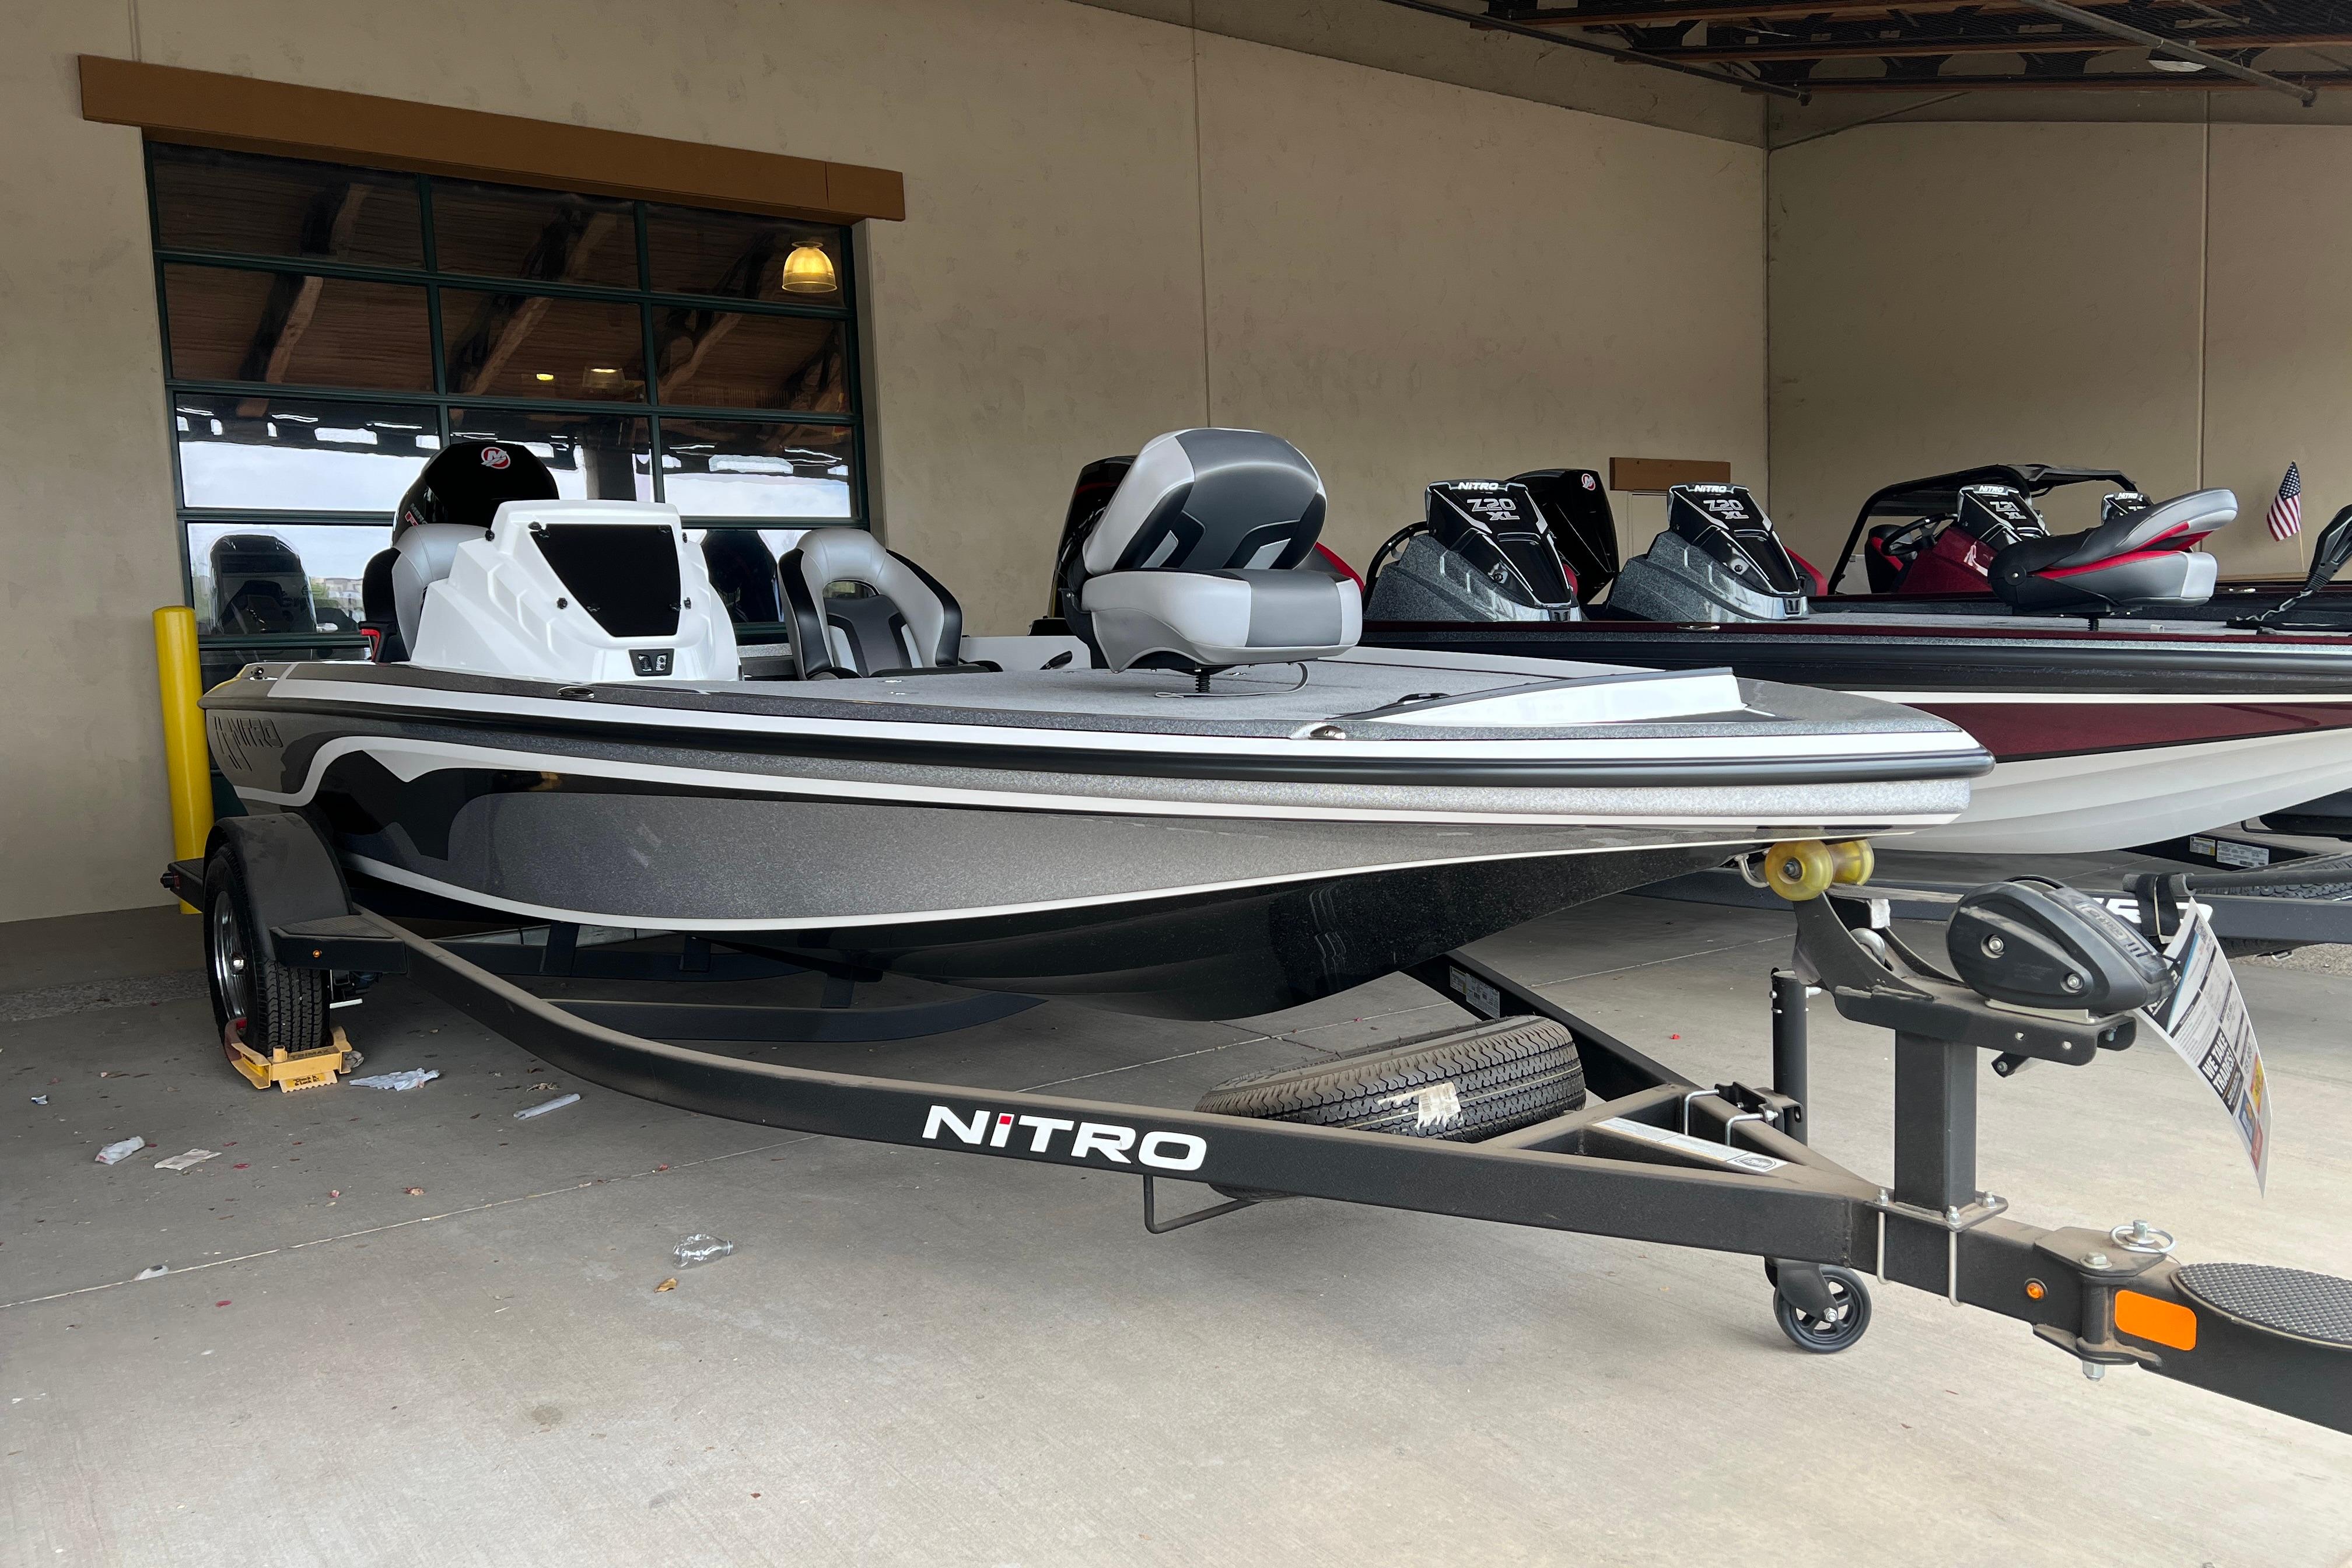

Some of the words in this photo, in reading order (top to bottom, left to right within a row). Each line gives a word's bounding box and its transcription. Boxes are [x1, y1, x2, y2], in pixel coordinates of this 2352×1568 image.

[1466, 498, 1517, 512] Z20
[1703, 499, 1744, 512] Z20
[1486, 511, 1520, 520] XL
[1721, 511, 1749, 519] XL
[2202, 1055, 2219, 1079] WE
[2211, 1031, 2228, 1062] TAKE
